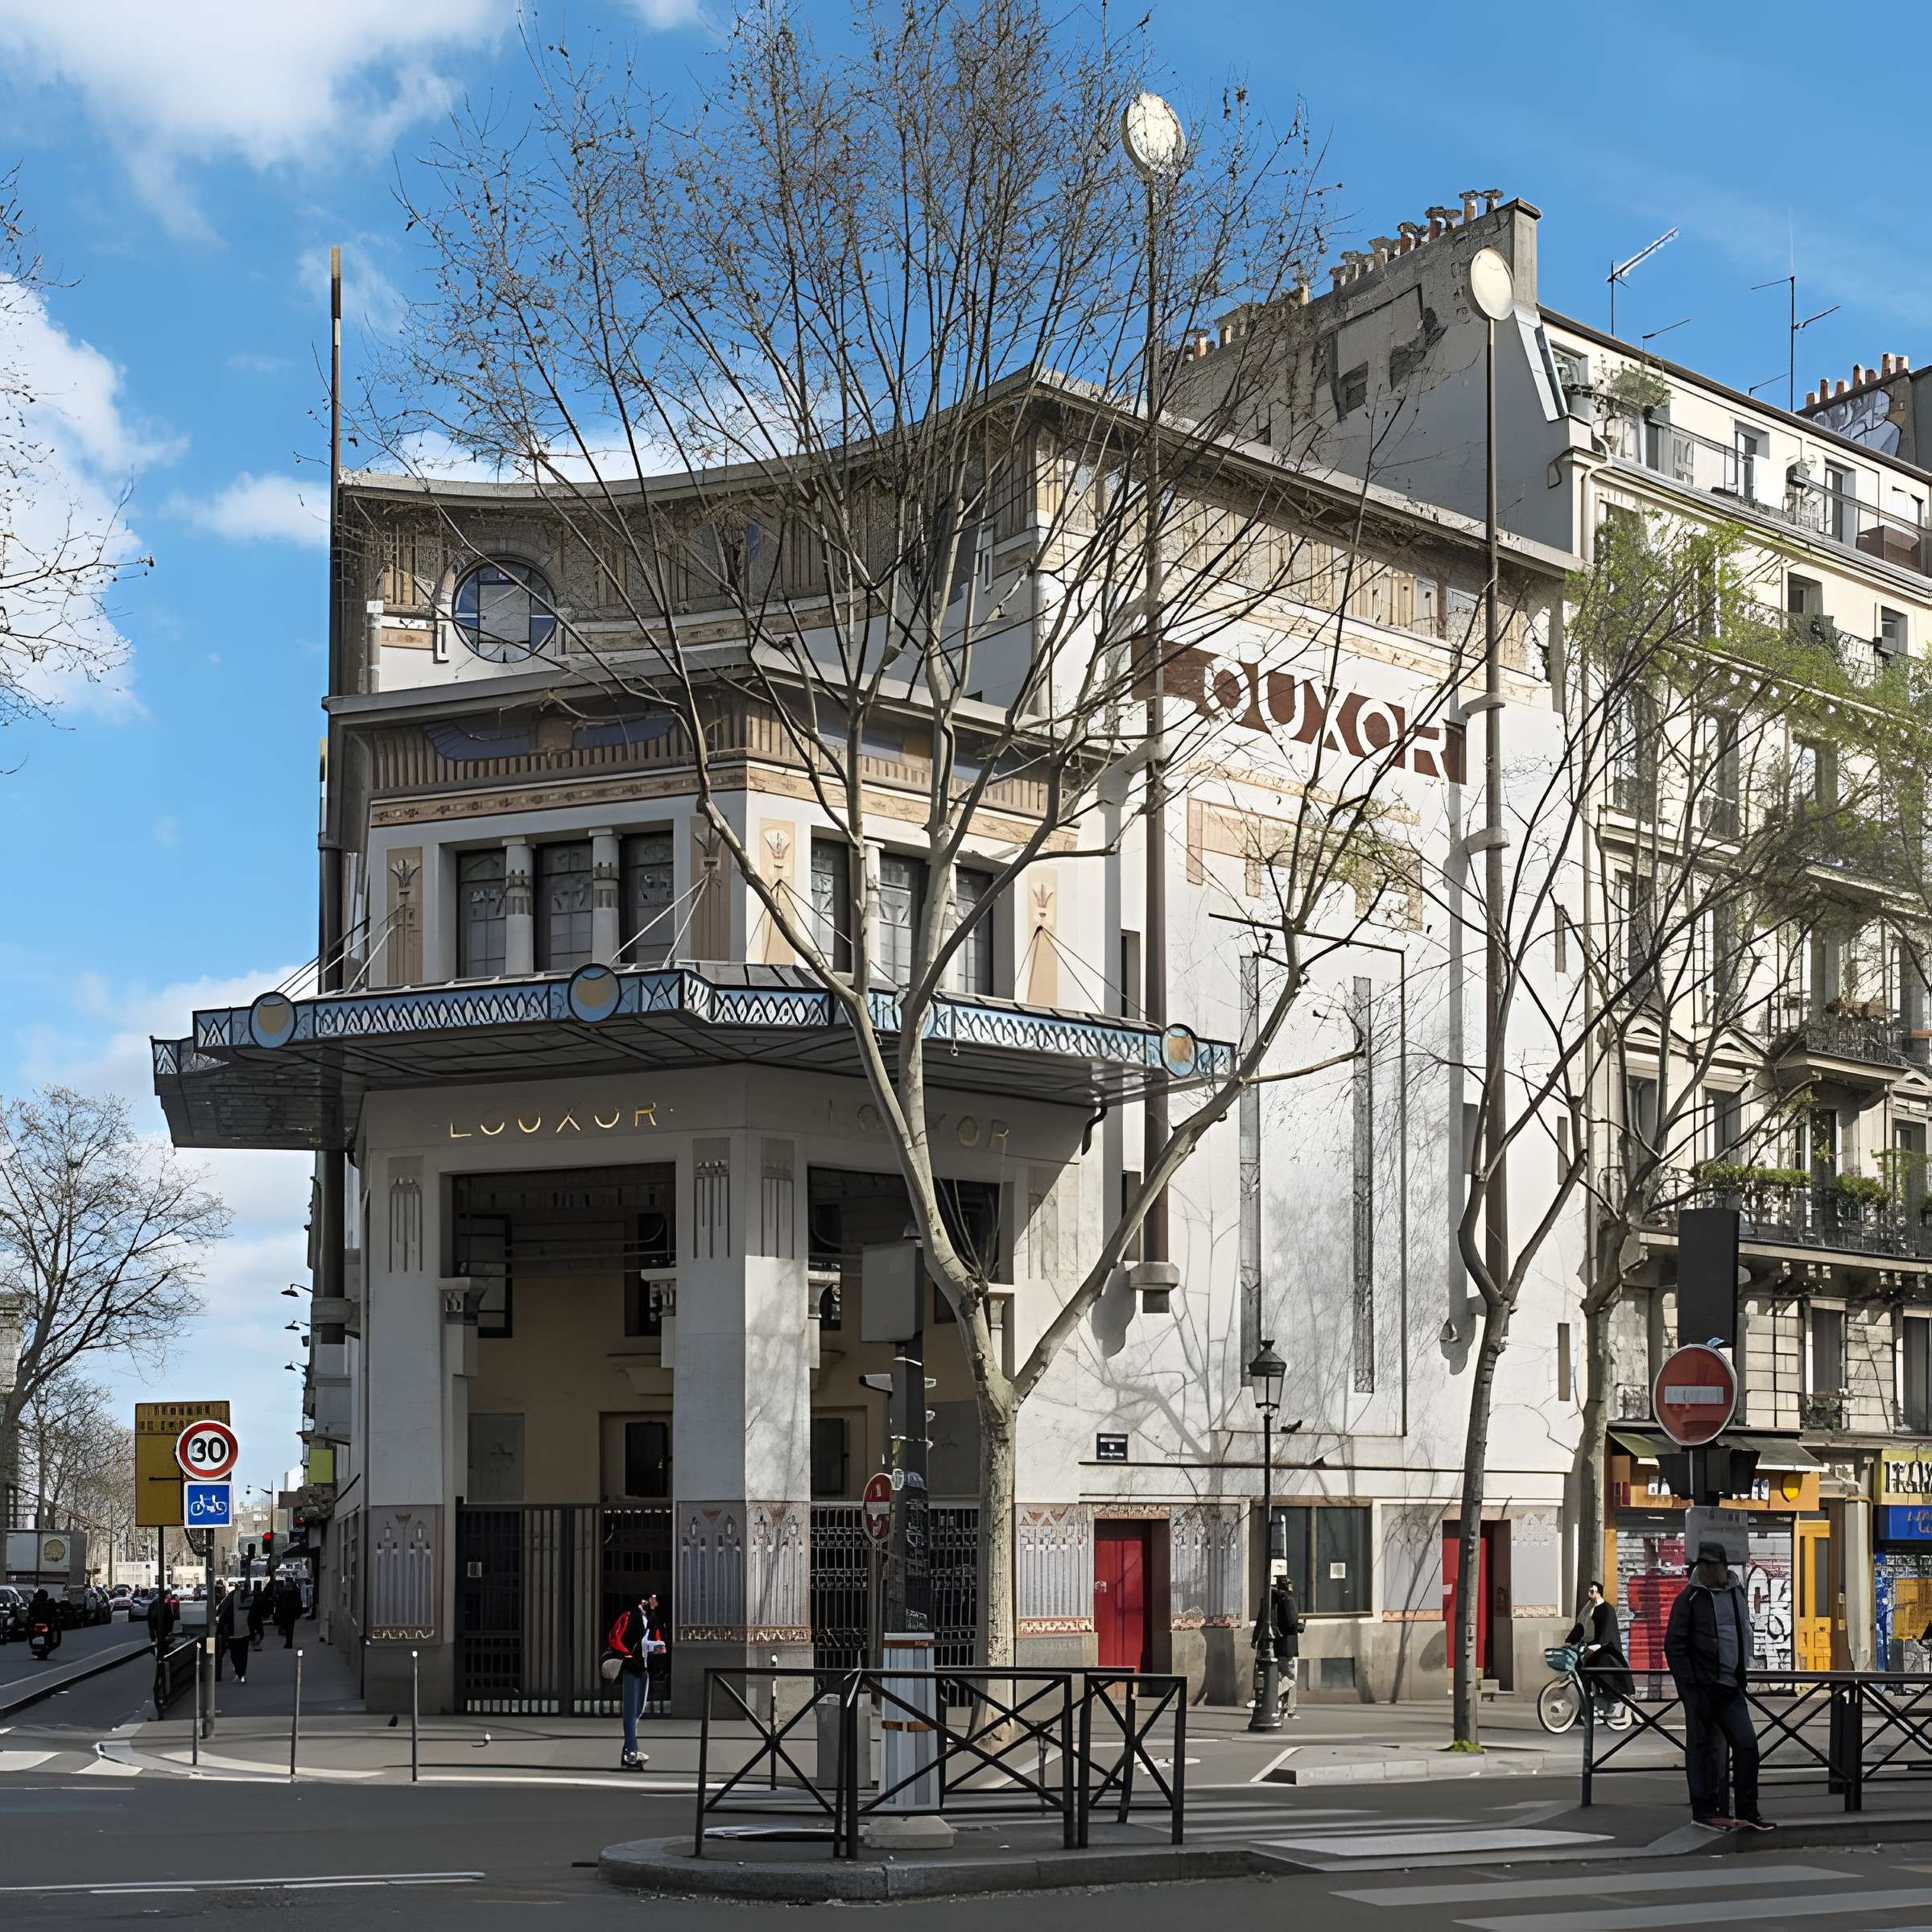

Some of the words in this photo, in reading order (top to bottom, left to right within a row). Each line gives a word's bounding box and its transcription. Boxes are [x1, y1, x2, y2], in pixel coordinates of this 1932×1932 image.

[1147, 638, 1449, 780] OUXOR
[828, 1098, 1009, 1149] LOOR
[189, 1437, 226, 1463] 30
